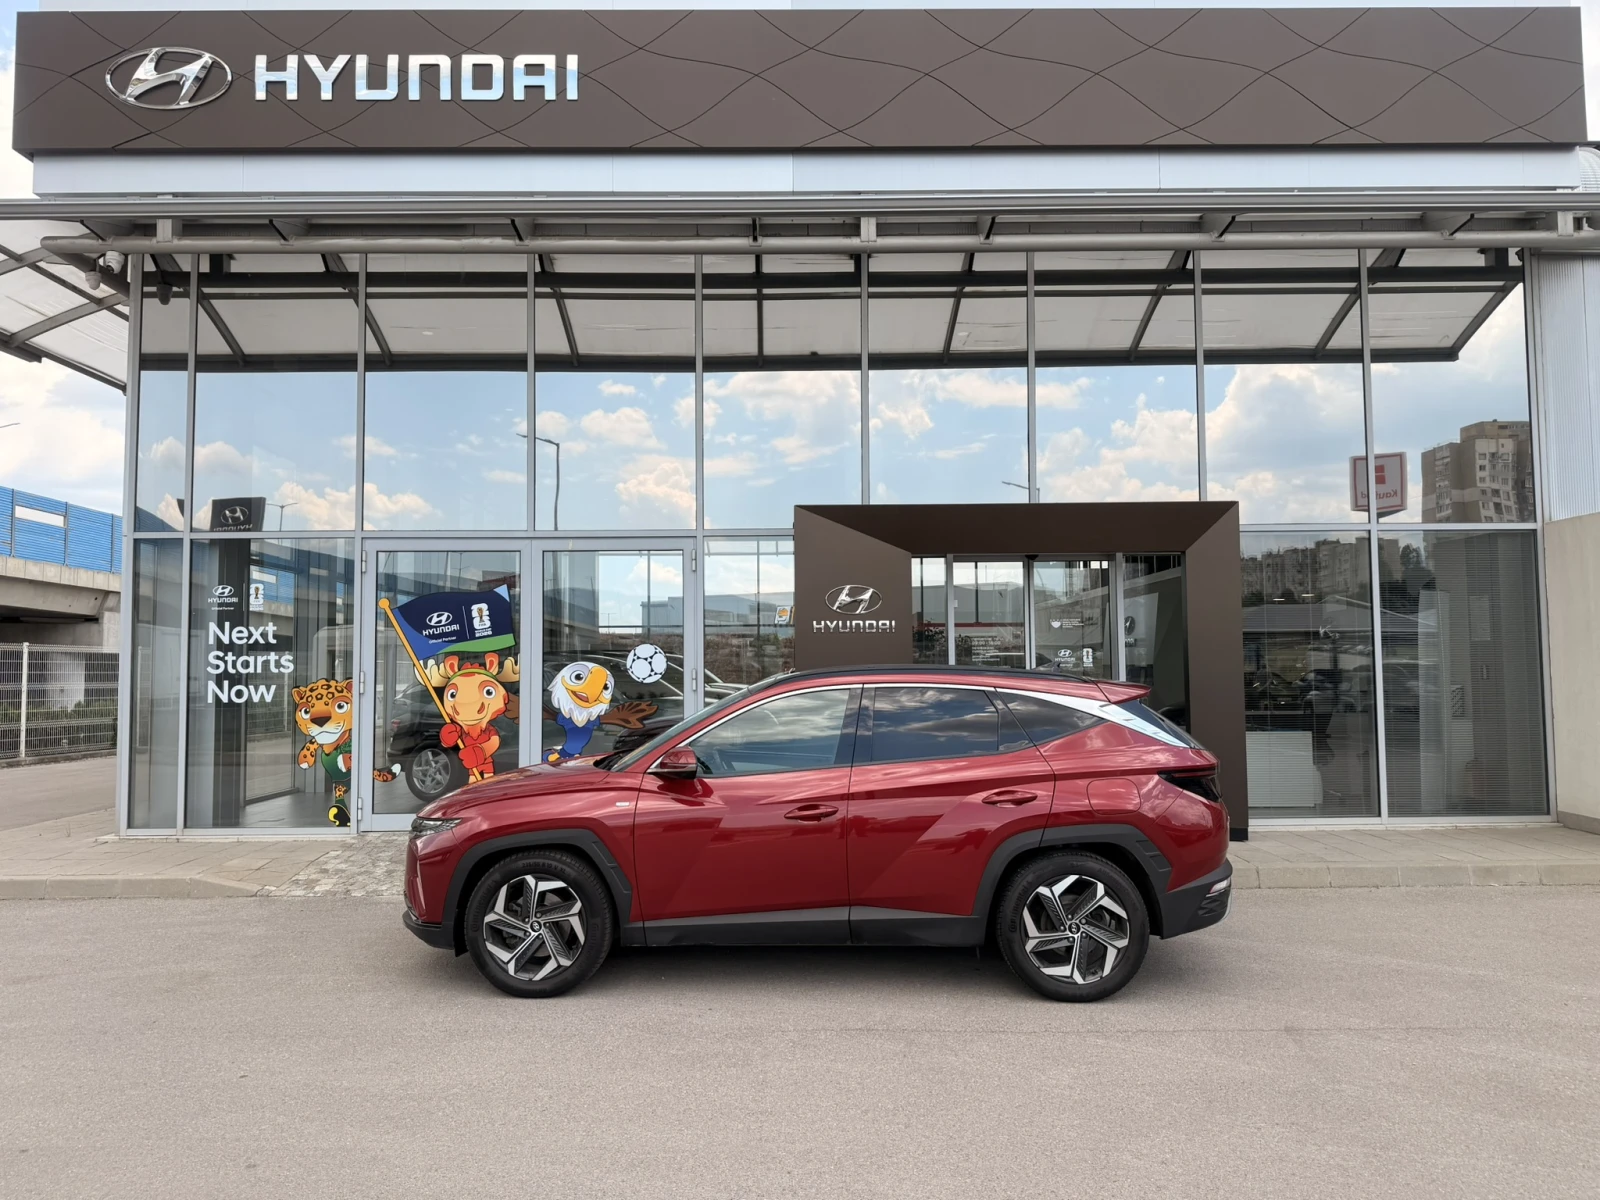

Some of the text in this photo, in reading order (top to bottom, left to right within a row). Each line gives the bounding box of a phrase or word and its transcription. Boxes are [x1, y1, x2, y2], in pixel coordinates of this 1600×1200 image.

[255, 54, 578, 101] HYUNDAI
[208, 621, 277, 645] Next
[422, 624, 460, 636] HYUNDAI
[812, 620, 896, 633] HYUNDAI
[206, 650, 294, 674] Starts
[207, 680, 277, 703] Now
